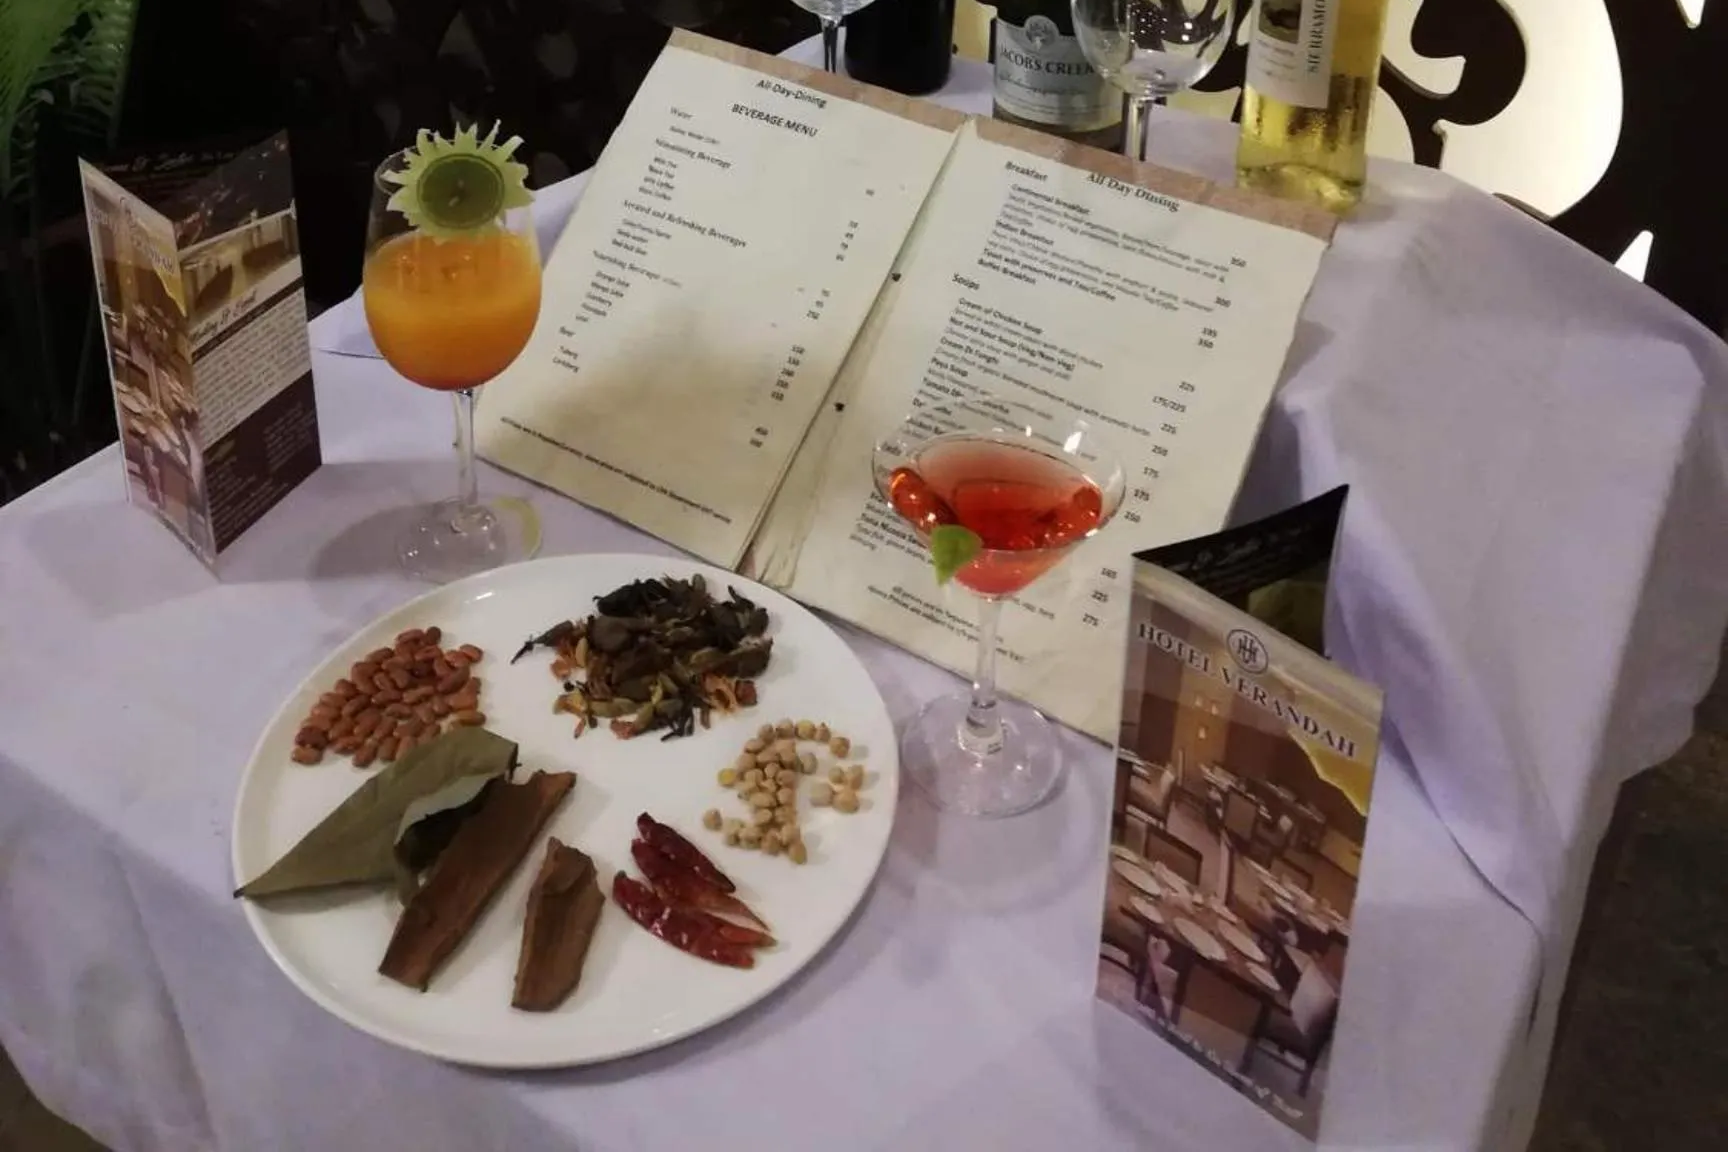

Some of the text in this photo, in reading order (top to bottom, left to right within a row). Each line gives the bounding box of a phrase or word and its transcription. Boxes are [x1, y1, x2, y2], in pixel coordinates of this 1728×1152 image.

[731, 103, 817, 137] BEVERAGE MENU
[1005, 161, 1047, 181] Breakfast
[1087, 172, 1180, 213] All Day Dining
[951, 272, 981, 290] Soups
[1139, 623, 1211, 673] HOTEL
[1219, 666, 1355, 757] VERANDAH
